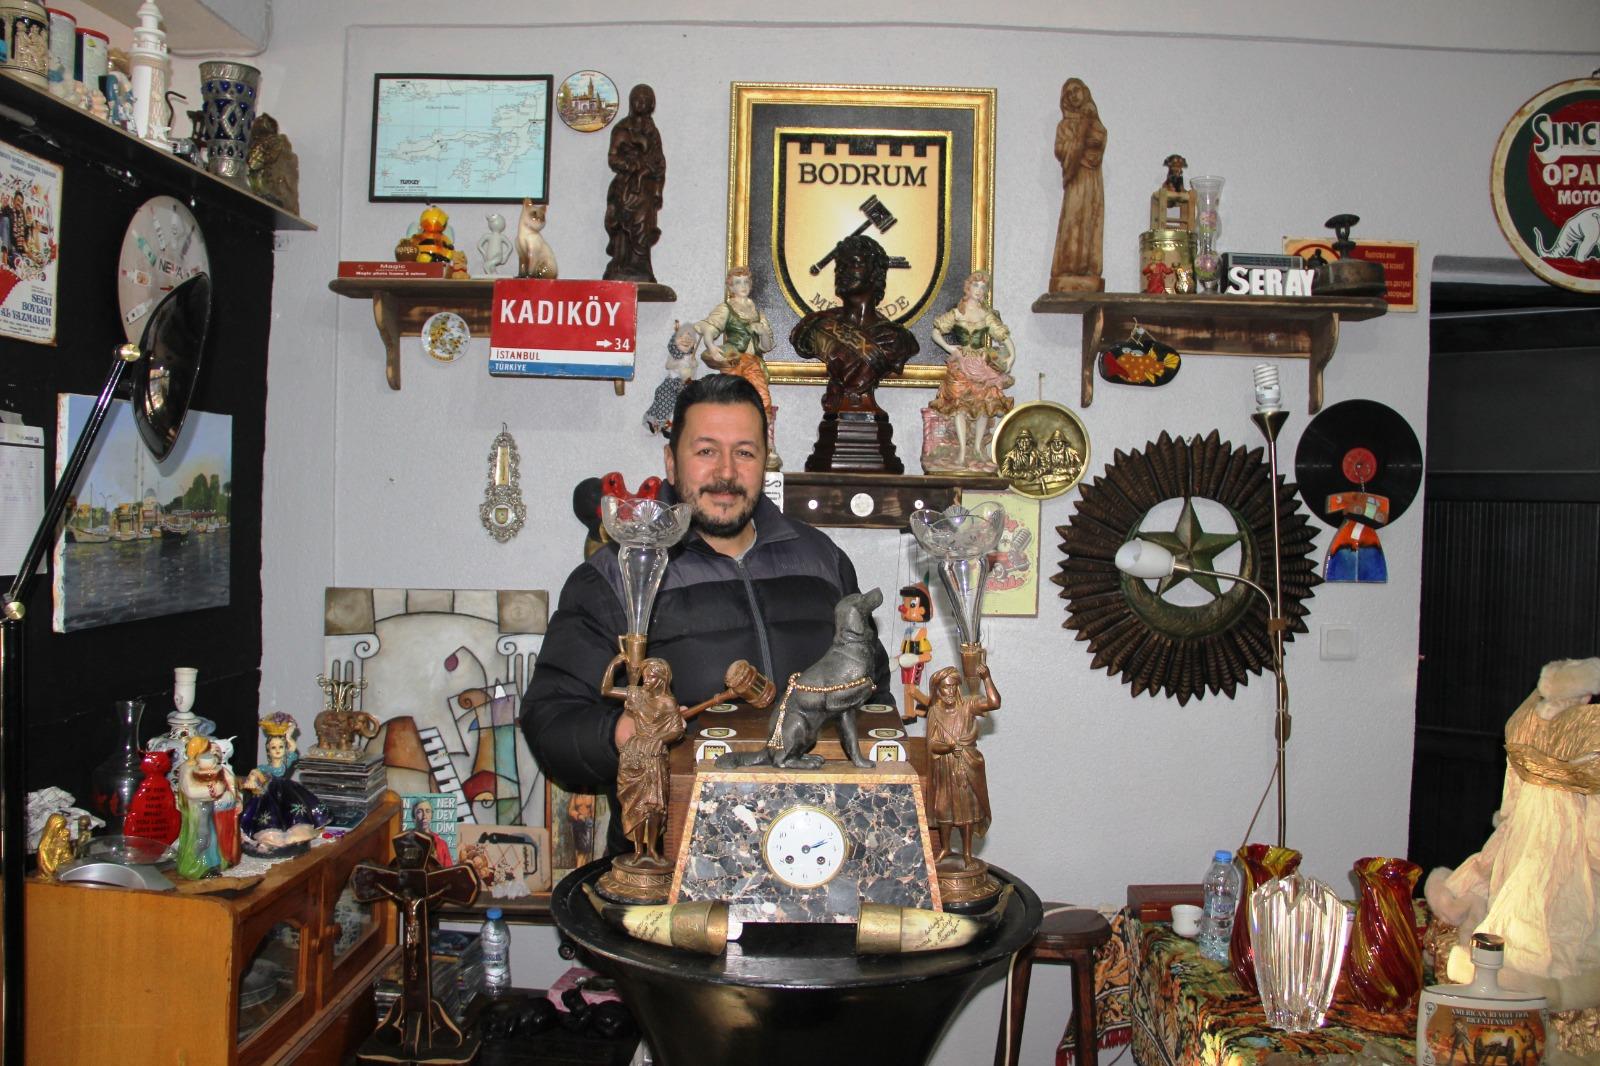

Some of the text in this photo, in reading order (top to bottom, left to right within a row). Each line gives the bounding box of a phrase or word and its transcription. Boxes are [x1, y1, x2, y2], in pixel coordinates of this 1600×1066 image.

[1533, 113, 1600, 152] SINC
[797, 162, 929, 188] BODRUM
[1226, 266, 1315, 297] SERAY
[500, 295, 621, 327] KADIKÖY
[614, 337, 631, 351] 34
[496, 350, 541, 361] İSTANBUL
[495, 362, 527, 372] TÜRKİYE
[436, 798, 455, 808] NER
[436, 809, 455, 820] DEY
[436, 821, 455, 832] DİM
[1451, 1008, 1487, 1018] AMERICAN
[1466, 1017, 1513, 1025] BICENTENNIAL
